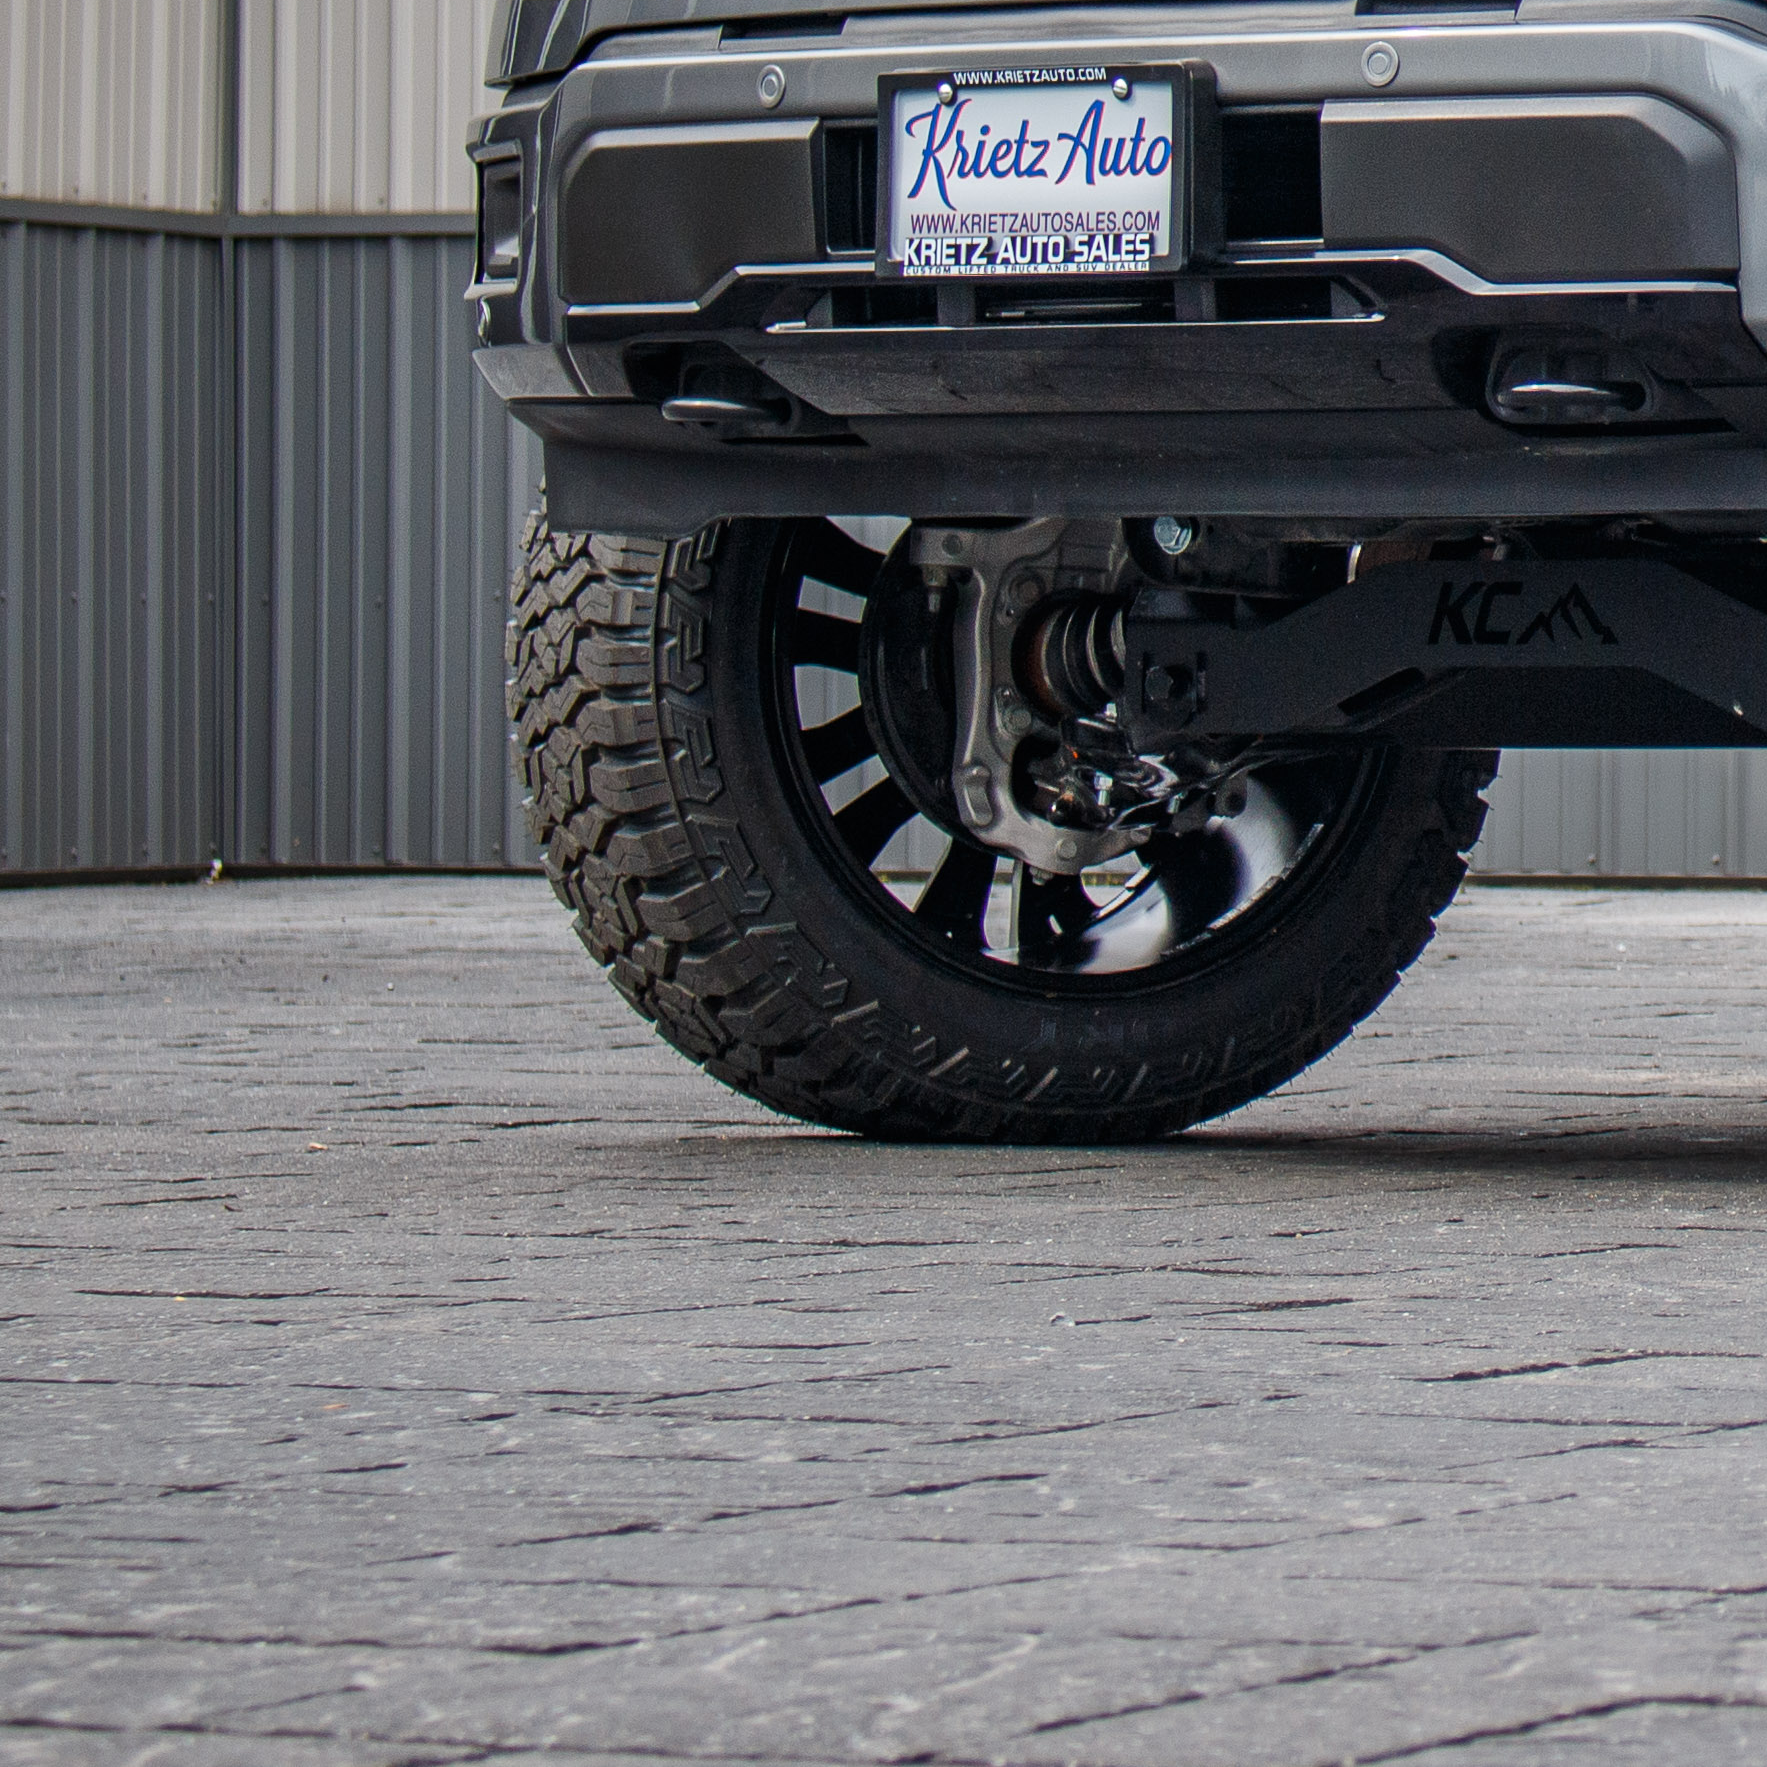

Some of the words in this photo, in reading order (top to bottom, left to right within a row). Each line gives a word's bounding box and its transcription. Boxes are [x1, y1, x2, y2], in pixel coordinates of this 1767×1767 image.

[953, 67, 1107, 85] WWW.KRIETZAUTO.COM
[904, 98, 1050, 211] Krietz
[1055, 99, 1172, 186] Auto
[910, 211, 1160, 235] WWW.KRIETZAUTOSALES.COM
[904, 236, 989, 266] KRIETZ
[996, 235, 1065, 265] AUTO
[1074, 233, 1150, 263] SALES
[905, 265, 951, 275] CUSTOM
[958, 265, 997, 275] LIFTED
[1004, 264, 1039, 274] TRUCK
[1047, 263, 1069, 273] AND
[1076, 263, 1098, 272] SUV
[1104, 262, 1148, 271] DEALER
